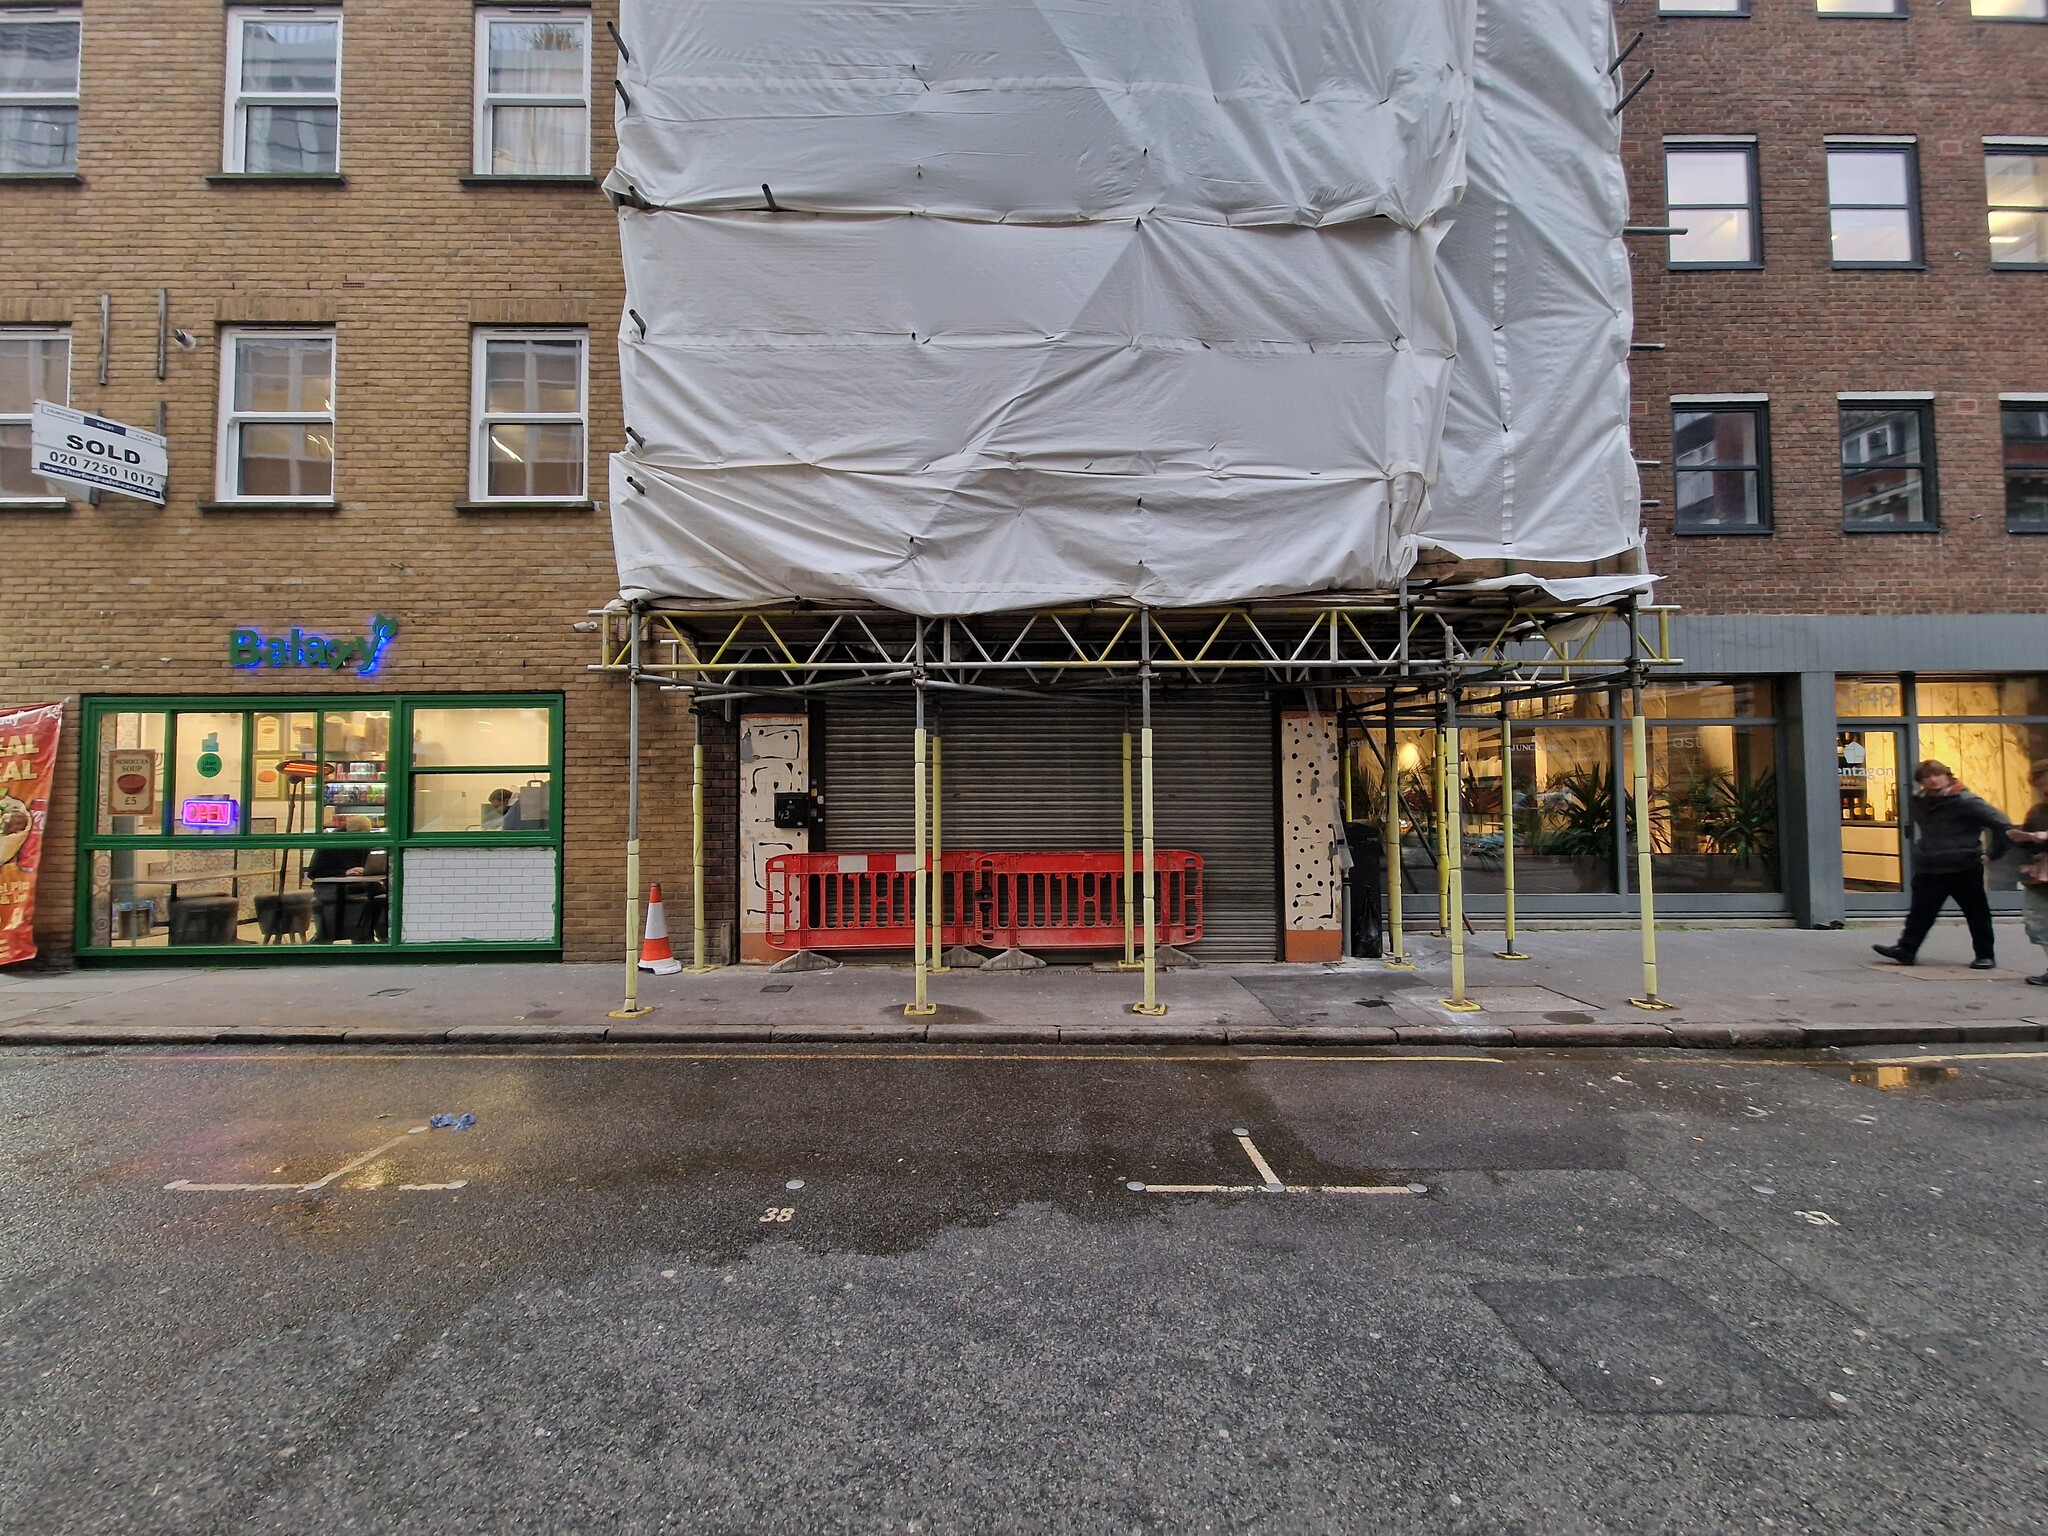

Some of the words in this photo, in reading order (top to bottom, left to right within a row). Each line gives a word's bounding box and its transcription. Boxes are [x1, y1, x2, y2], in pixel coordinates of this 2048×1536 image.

[66, 434, 141, 465] SOLD
[42, 464, 158, 496] www.hurford-salvi-carr.co.uk
[49, 451, 77, 467] 020
[83, 459, 118, 477] 7250
[123, 469, 155, 487] 1012
[0, 759, 38, 782] AL
[125, 796, 137, 806] £5
[185, 804, 229, 823] OPEN
[759, 1207, 795, 1222] 38
